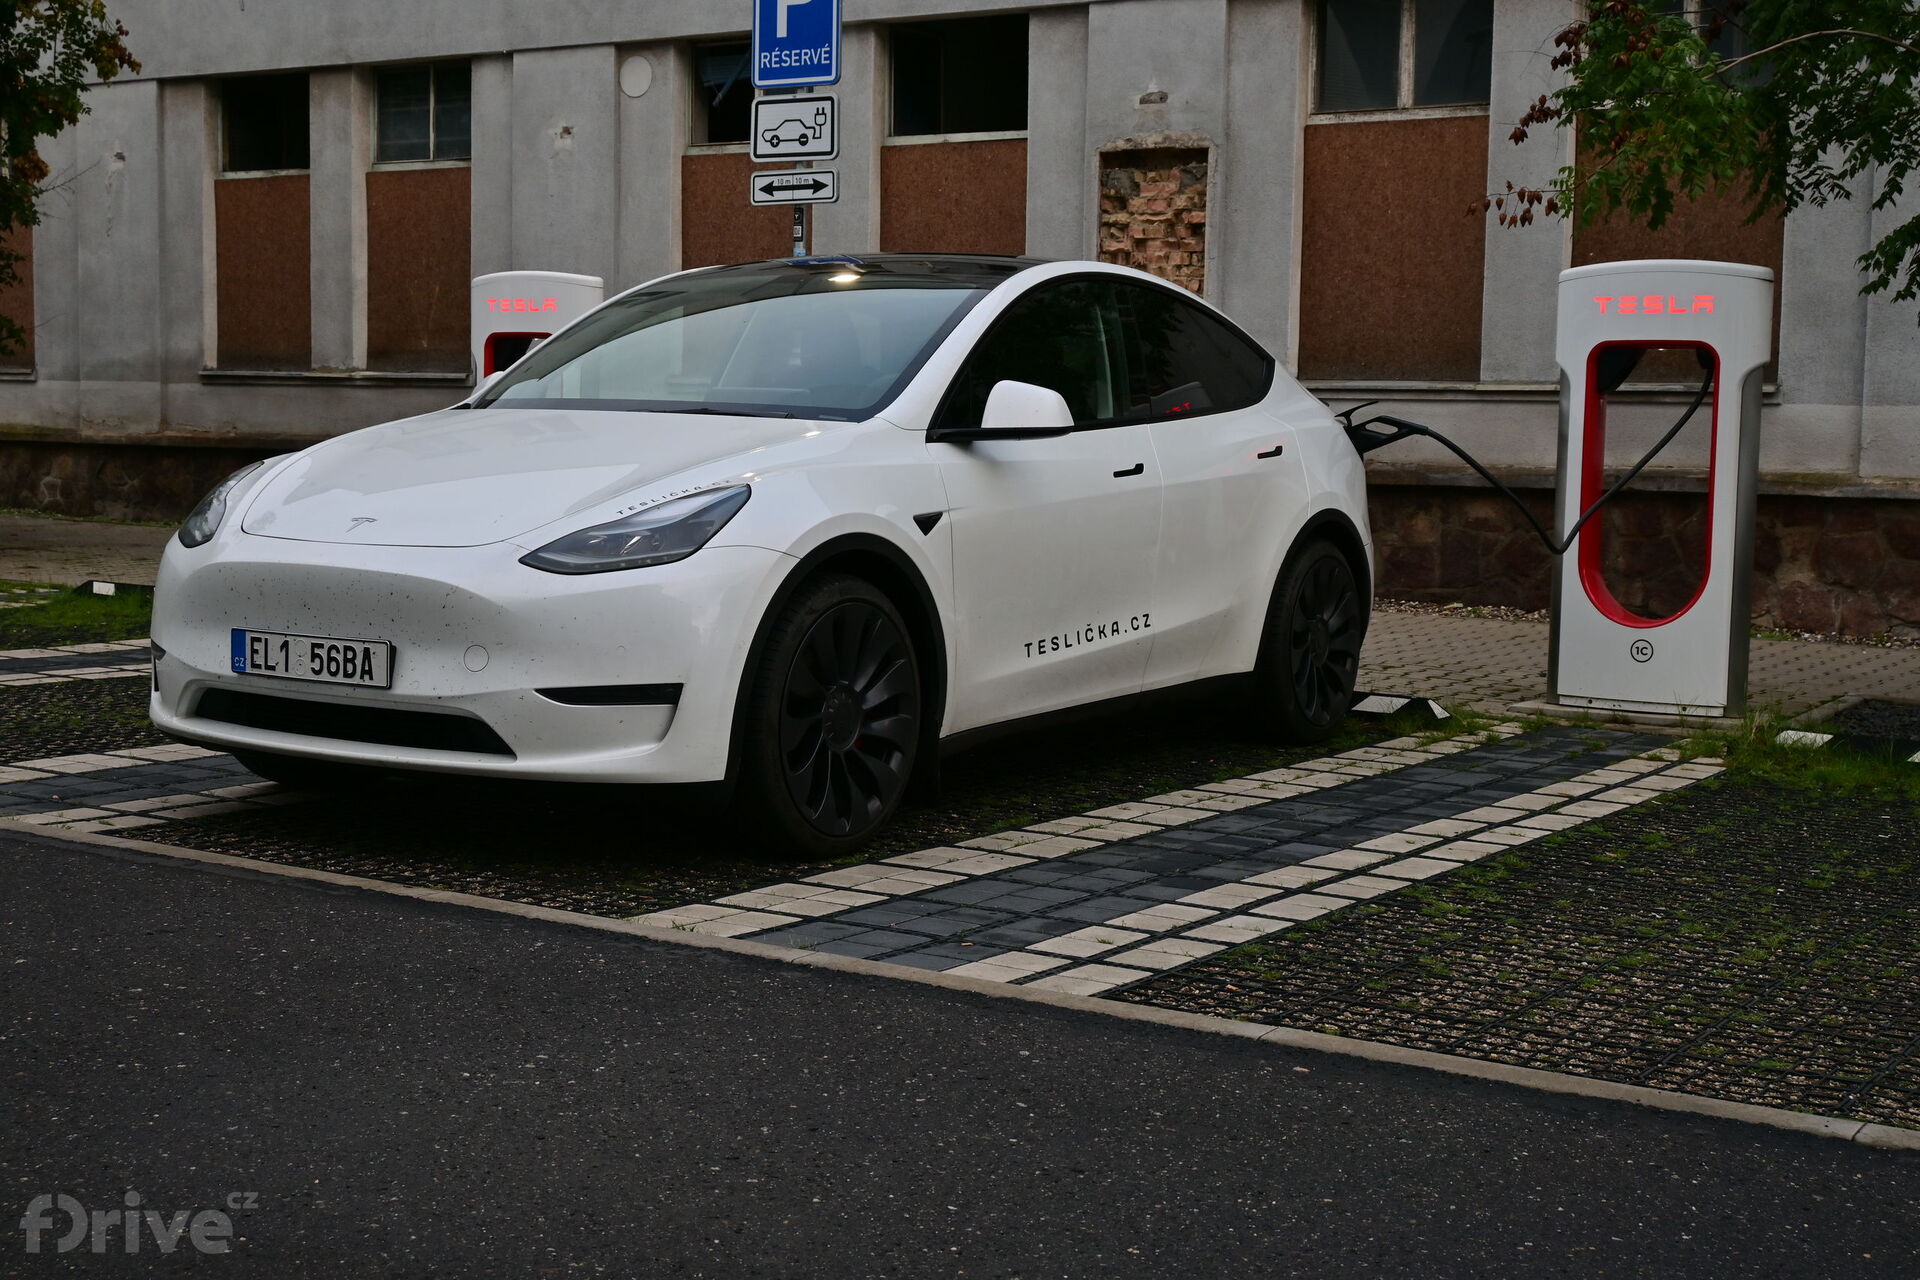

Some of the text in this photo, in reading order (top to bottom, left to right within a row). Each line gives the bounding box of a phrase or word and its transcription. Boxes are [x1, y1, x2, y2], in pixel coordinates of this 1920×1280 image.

[760, 43, 831, 69] RÉSERVÉ
[486, 298, 558, 313] TESLA
[1593, 295, 1715, 315] TESLA
[1024, 613, 1151, 658] TESLIČKA.CZ
[250, 636, 374, 681] EL1 56BA
[1635, 646, 1648, 656] 1C
